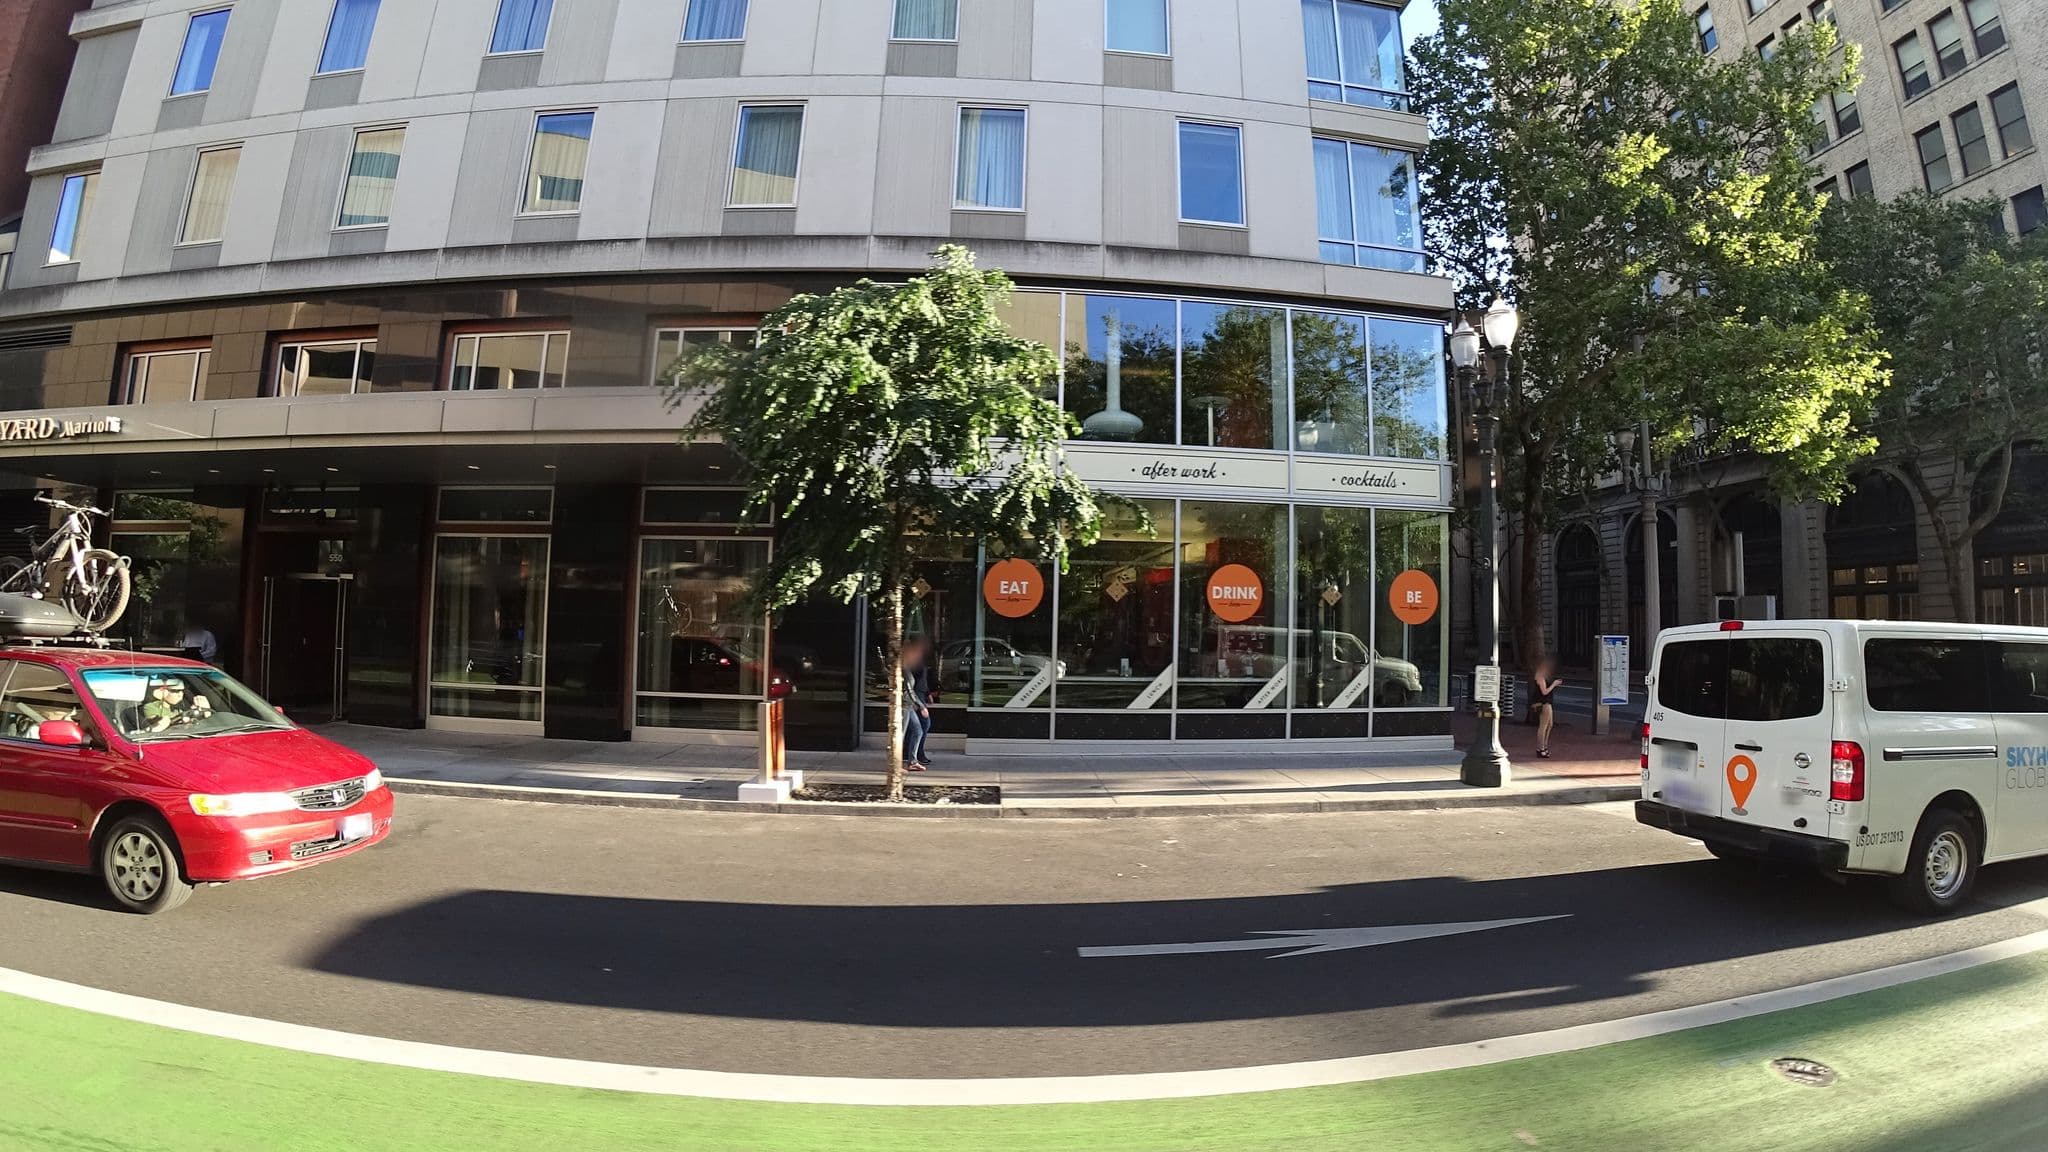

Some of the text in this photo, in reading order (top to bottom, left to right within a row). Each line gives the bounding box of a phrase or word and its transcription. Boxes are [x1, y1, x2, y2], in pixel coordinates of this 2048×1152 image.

[1141, 461, 1217, 479] after work
[1340, 470, 1397, 488] cocktails
[1000, 580, 1029, 595] EAT
[1212, 585, 1258, 600] DRINK
[1406, 590, 1422, 604] BE
[1020, 676, 1047, 702] BREAKFAST
[1653, 711, 1665, 722] 405
[2006, 745, 2048, 768] SKYH
[1856, 835, 1865, 847] US
[1866, 832, 1880, 846] DOT
